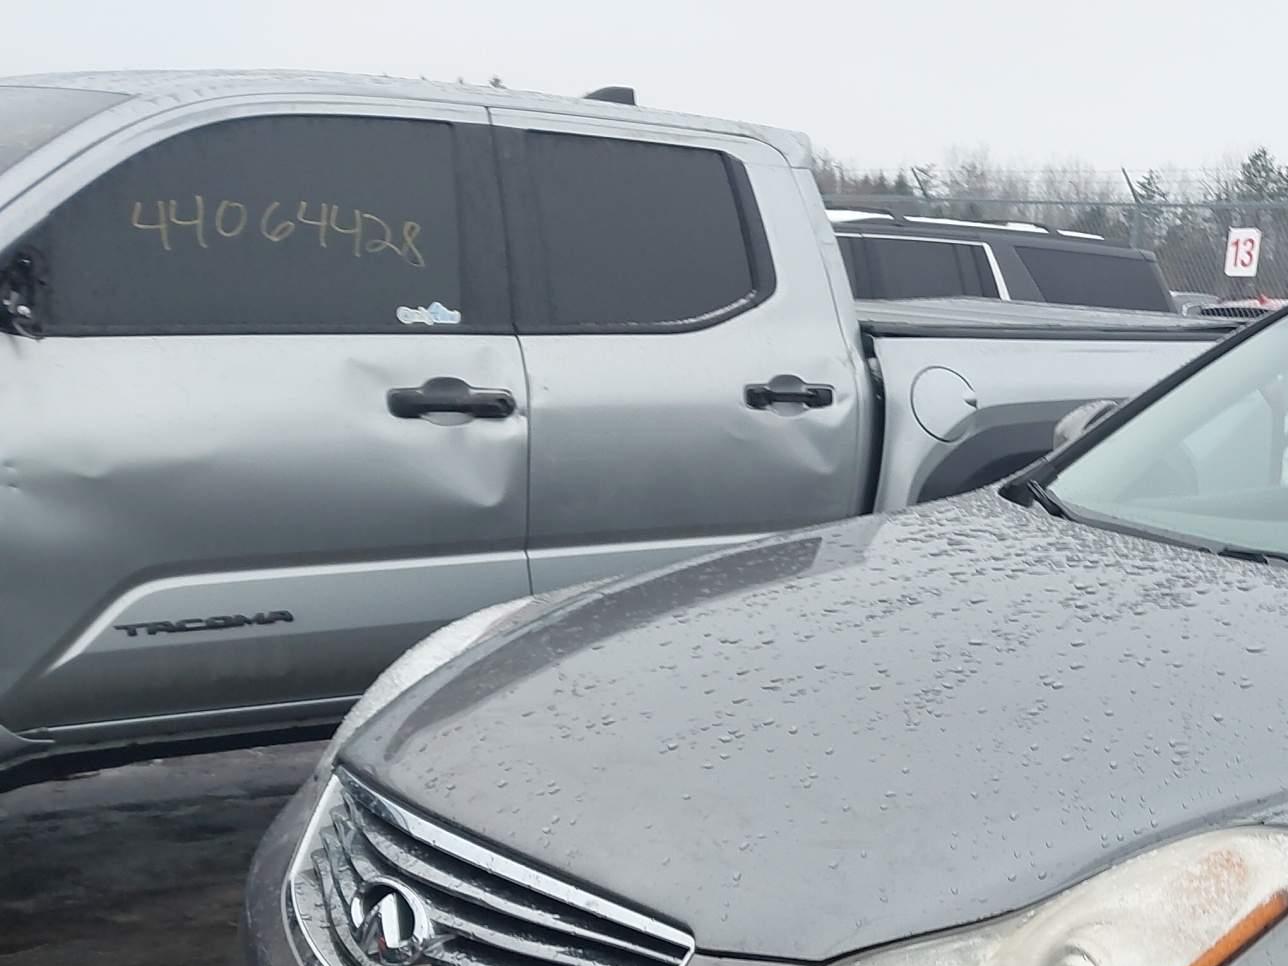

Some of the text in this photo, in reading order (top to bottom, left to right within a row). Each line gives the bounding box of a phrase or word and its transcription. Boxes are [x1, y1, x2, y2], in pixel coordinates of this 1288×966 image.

[131, 195, 426, 268] 44064428
[1231, 238, 1255, 268] 13
[113, 610, 294, 637] TACOMA
